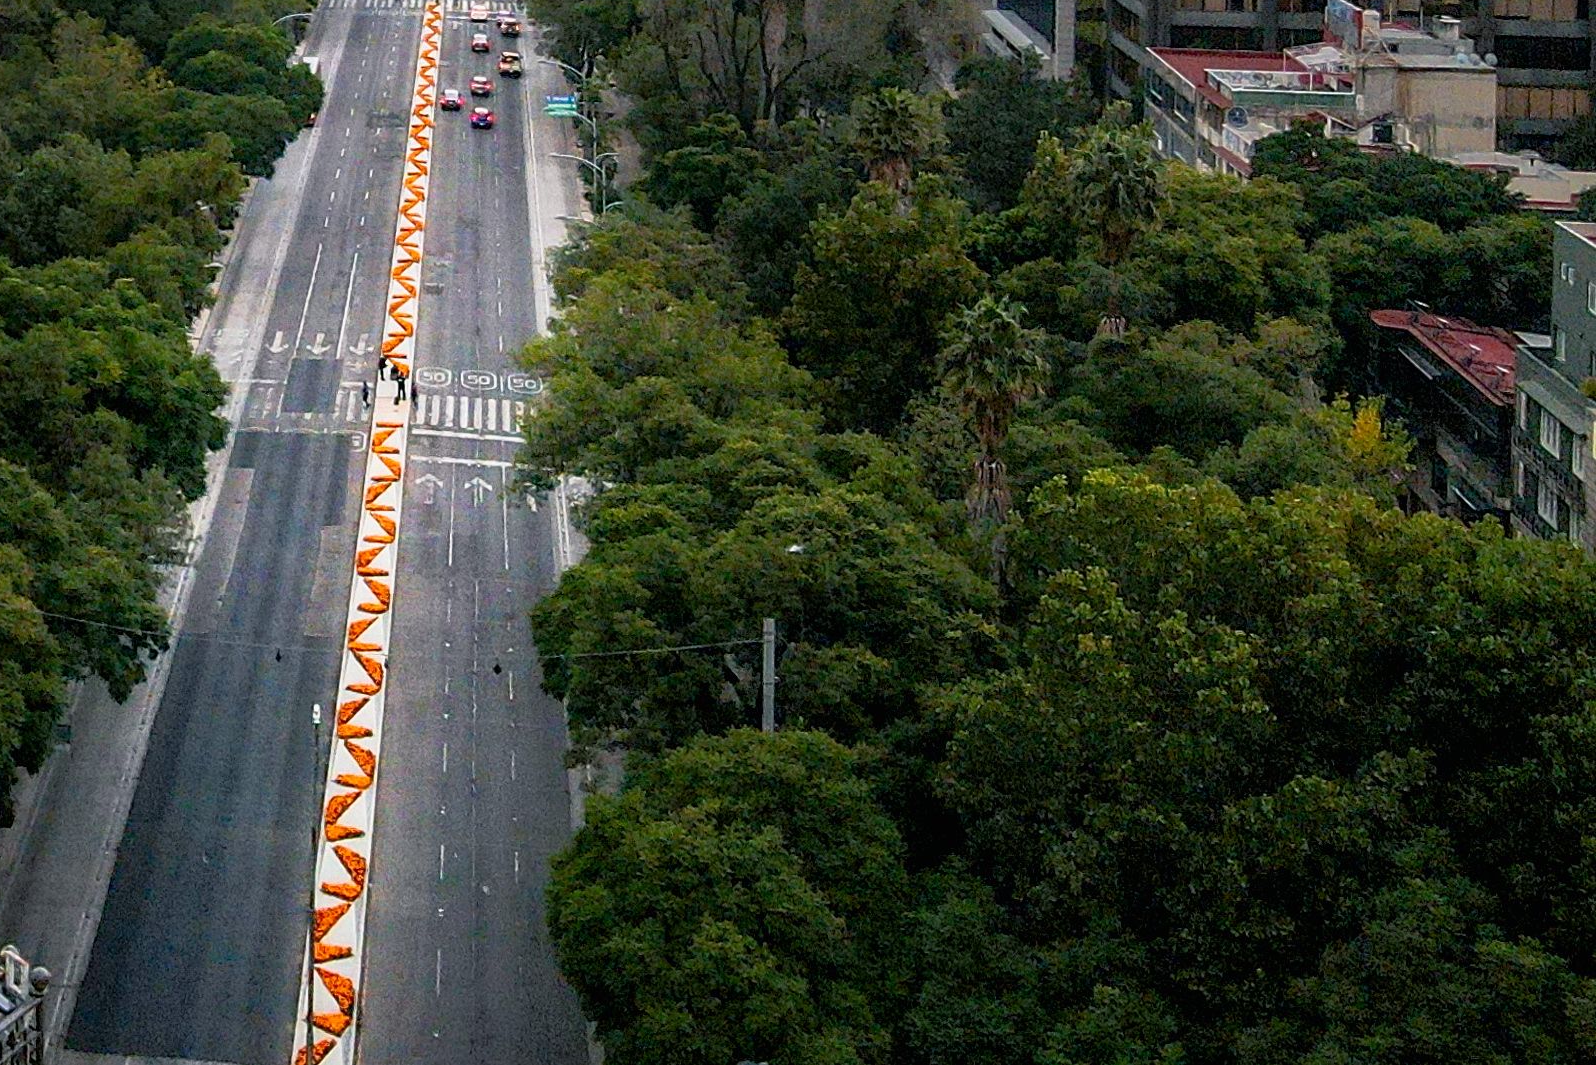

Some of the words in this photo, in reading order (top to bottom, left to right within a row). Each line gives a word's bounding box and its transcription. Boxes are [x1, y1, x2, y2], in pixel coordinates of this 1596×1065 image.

[423, 371, 446, 383] 50
[467, 375, 491, 385] 50
[513, 378, 537, 389] 50
